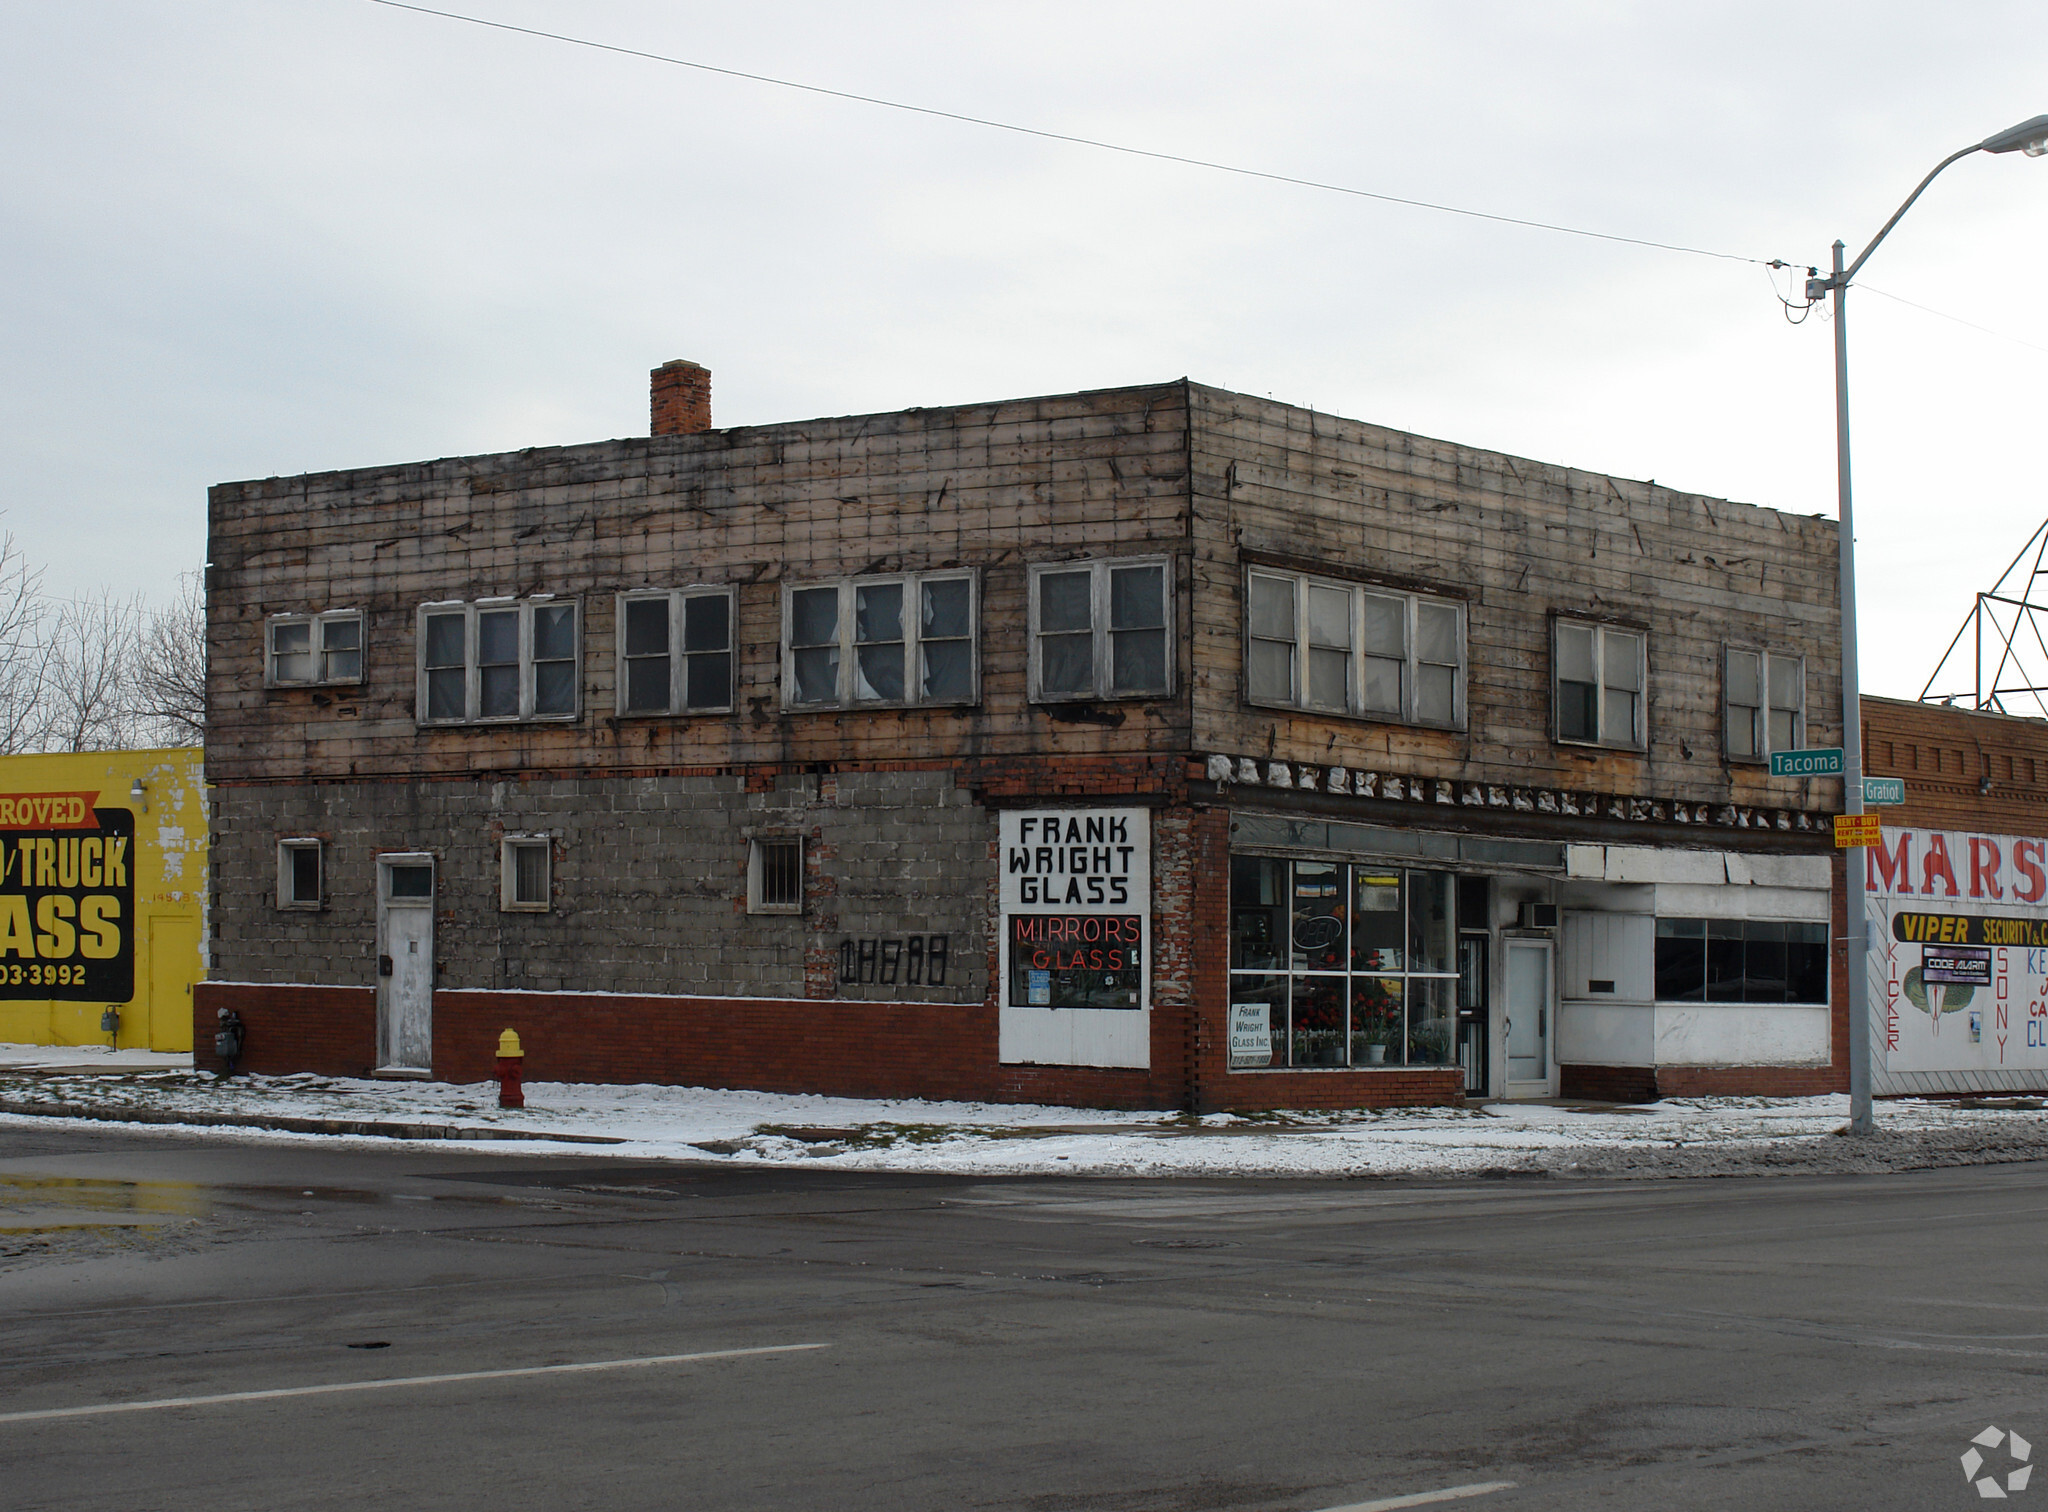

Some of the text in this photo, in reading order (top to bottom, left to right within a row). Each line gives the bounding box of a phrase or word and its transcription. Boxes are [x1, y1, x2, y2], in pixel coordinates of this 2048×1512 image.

[1775, 755, 1838, 772] Tacoma
[1867, 782, 1899, 800] Gratiot
[1020, 816, 1127, 844] FRANK
[1837, 817, 1876, 826] RENT BUY
[1864, 828, 1878, 836] OWN
[0, 836, 127, 888] /TRUCK
[1009, 846, 1134, 874] WRIGHT
[1866, 832, 2047, 903] MARS
[1020, 876, 1128, 904] GLASS
[1016, 918, 1140, 942] MIRRORS
[1294, 920, 1338, 945] OPEN
[1903, 914, 1968, 943] VIPER
[1983, 918, 2032, 945] SECURITY
[1033, 950, 1123, 971] GLASS
[1928, 958, 1987, 971] CODE ALARM
[1887, 943, 1899, 1052] KICKER
[1997, 948, 2009, 1064] SONY
